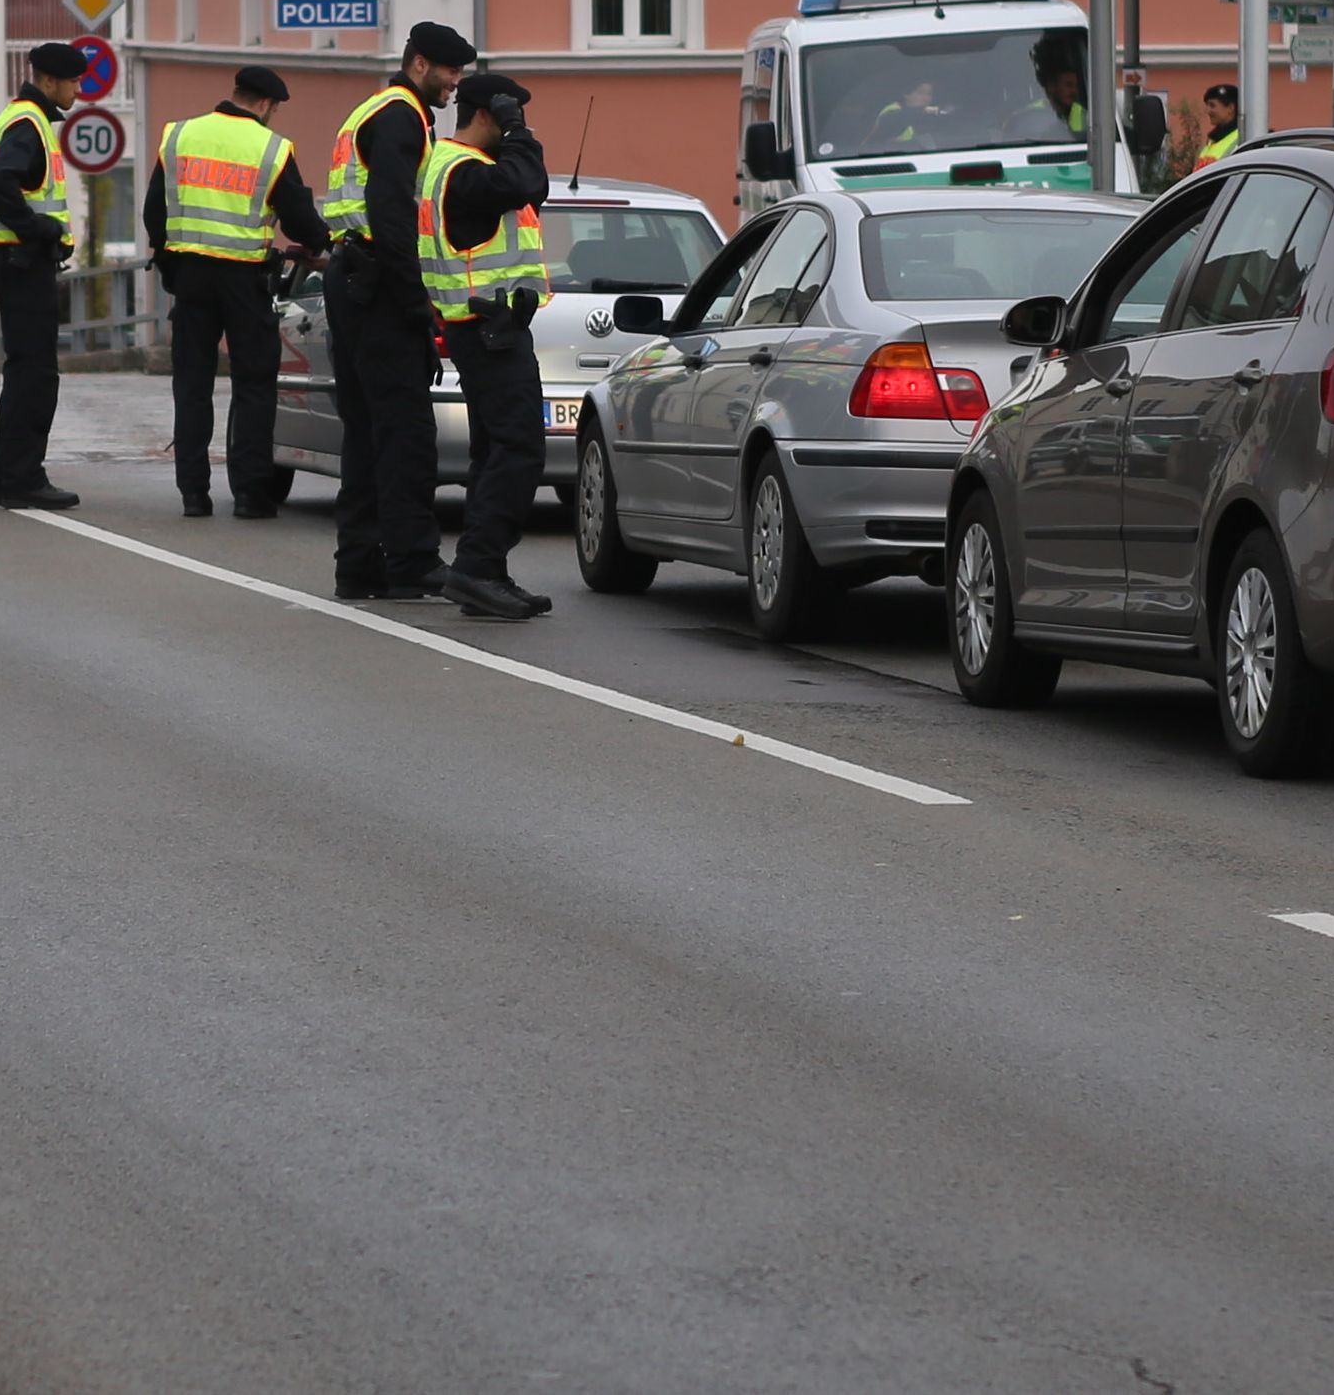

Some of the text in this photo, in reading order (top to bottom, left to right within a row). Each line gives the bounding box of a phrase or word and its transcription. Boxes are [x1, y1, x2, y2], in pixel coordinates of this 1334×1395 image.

[282, 2, 373, 24] POLIZEI
[75, 125, 113, 155] 50
[555, 404, 579, 424] BR
